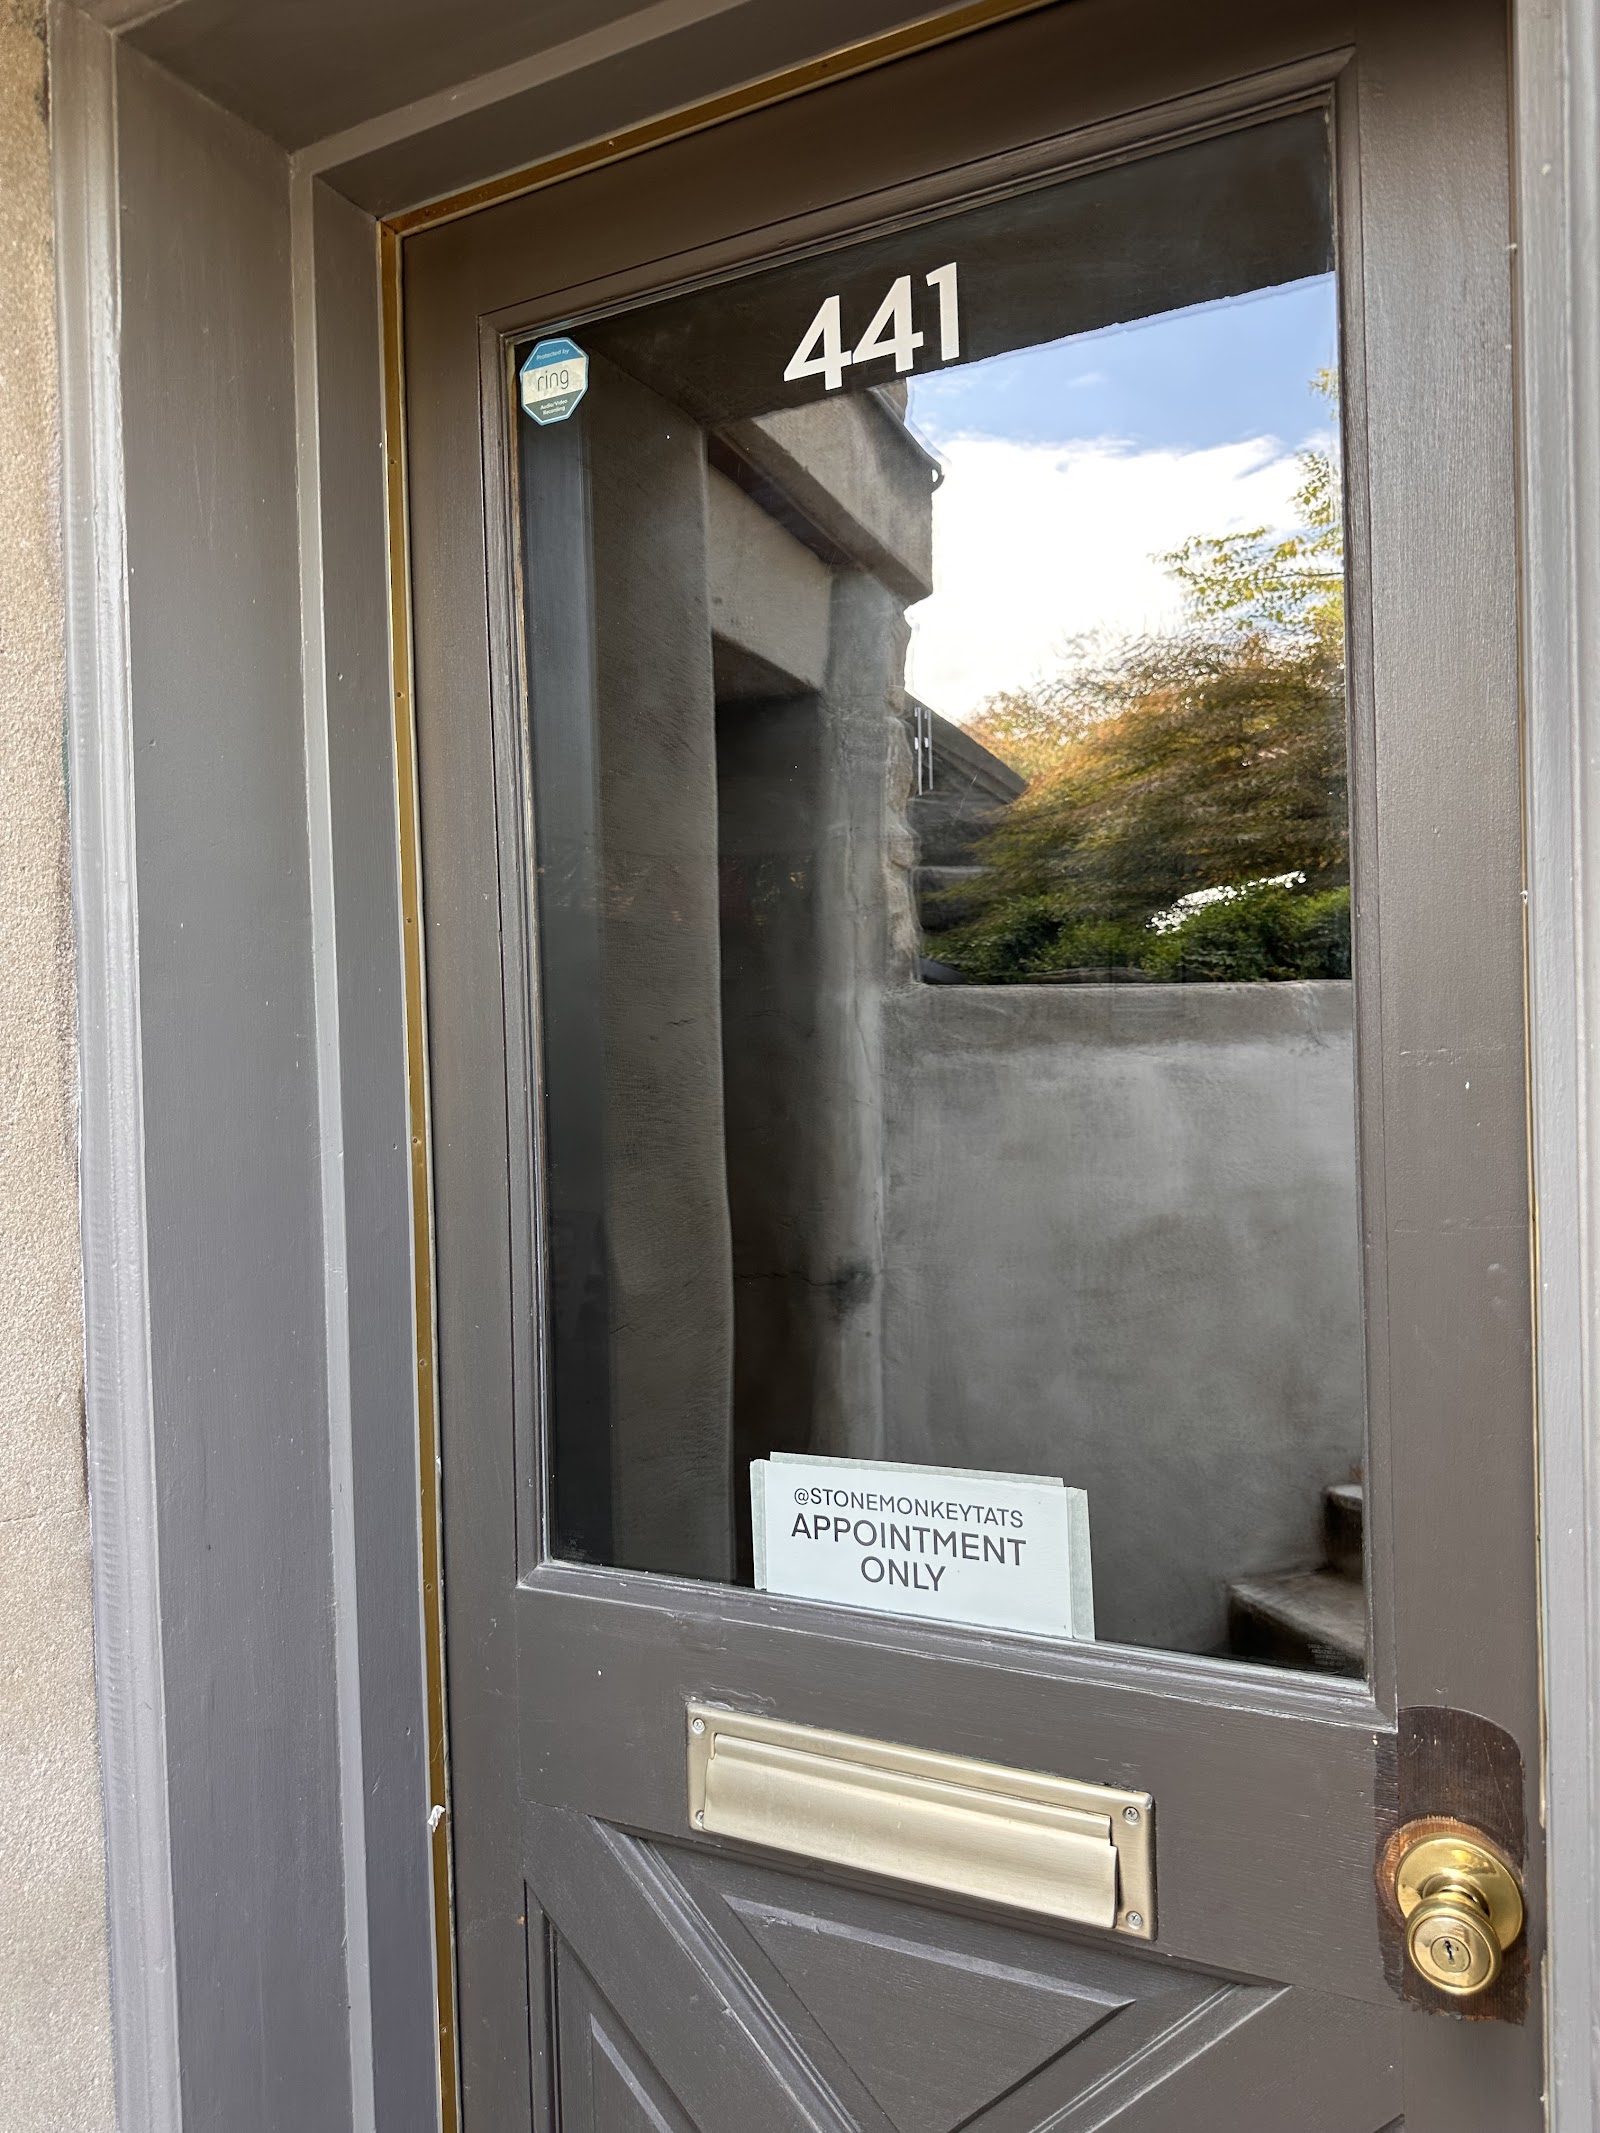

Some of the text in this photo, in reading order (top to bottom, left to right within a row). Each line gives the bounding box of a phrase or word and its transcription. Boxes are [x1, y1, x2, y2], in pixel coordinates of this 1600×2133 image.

[783, 262, 960, 391] 441
[536, 350, 561, 360] Protected
[537, 369, 569, 391] ring
[543, 406, 565, 415] Recording
[794, 1488, 1024, 1528] @STONEMONKEYTATS
[791, 1513, 1027, 1566] APPOINTMENT
[861, 1556, 946, 1592] ONLY
